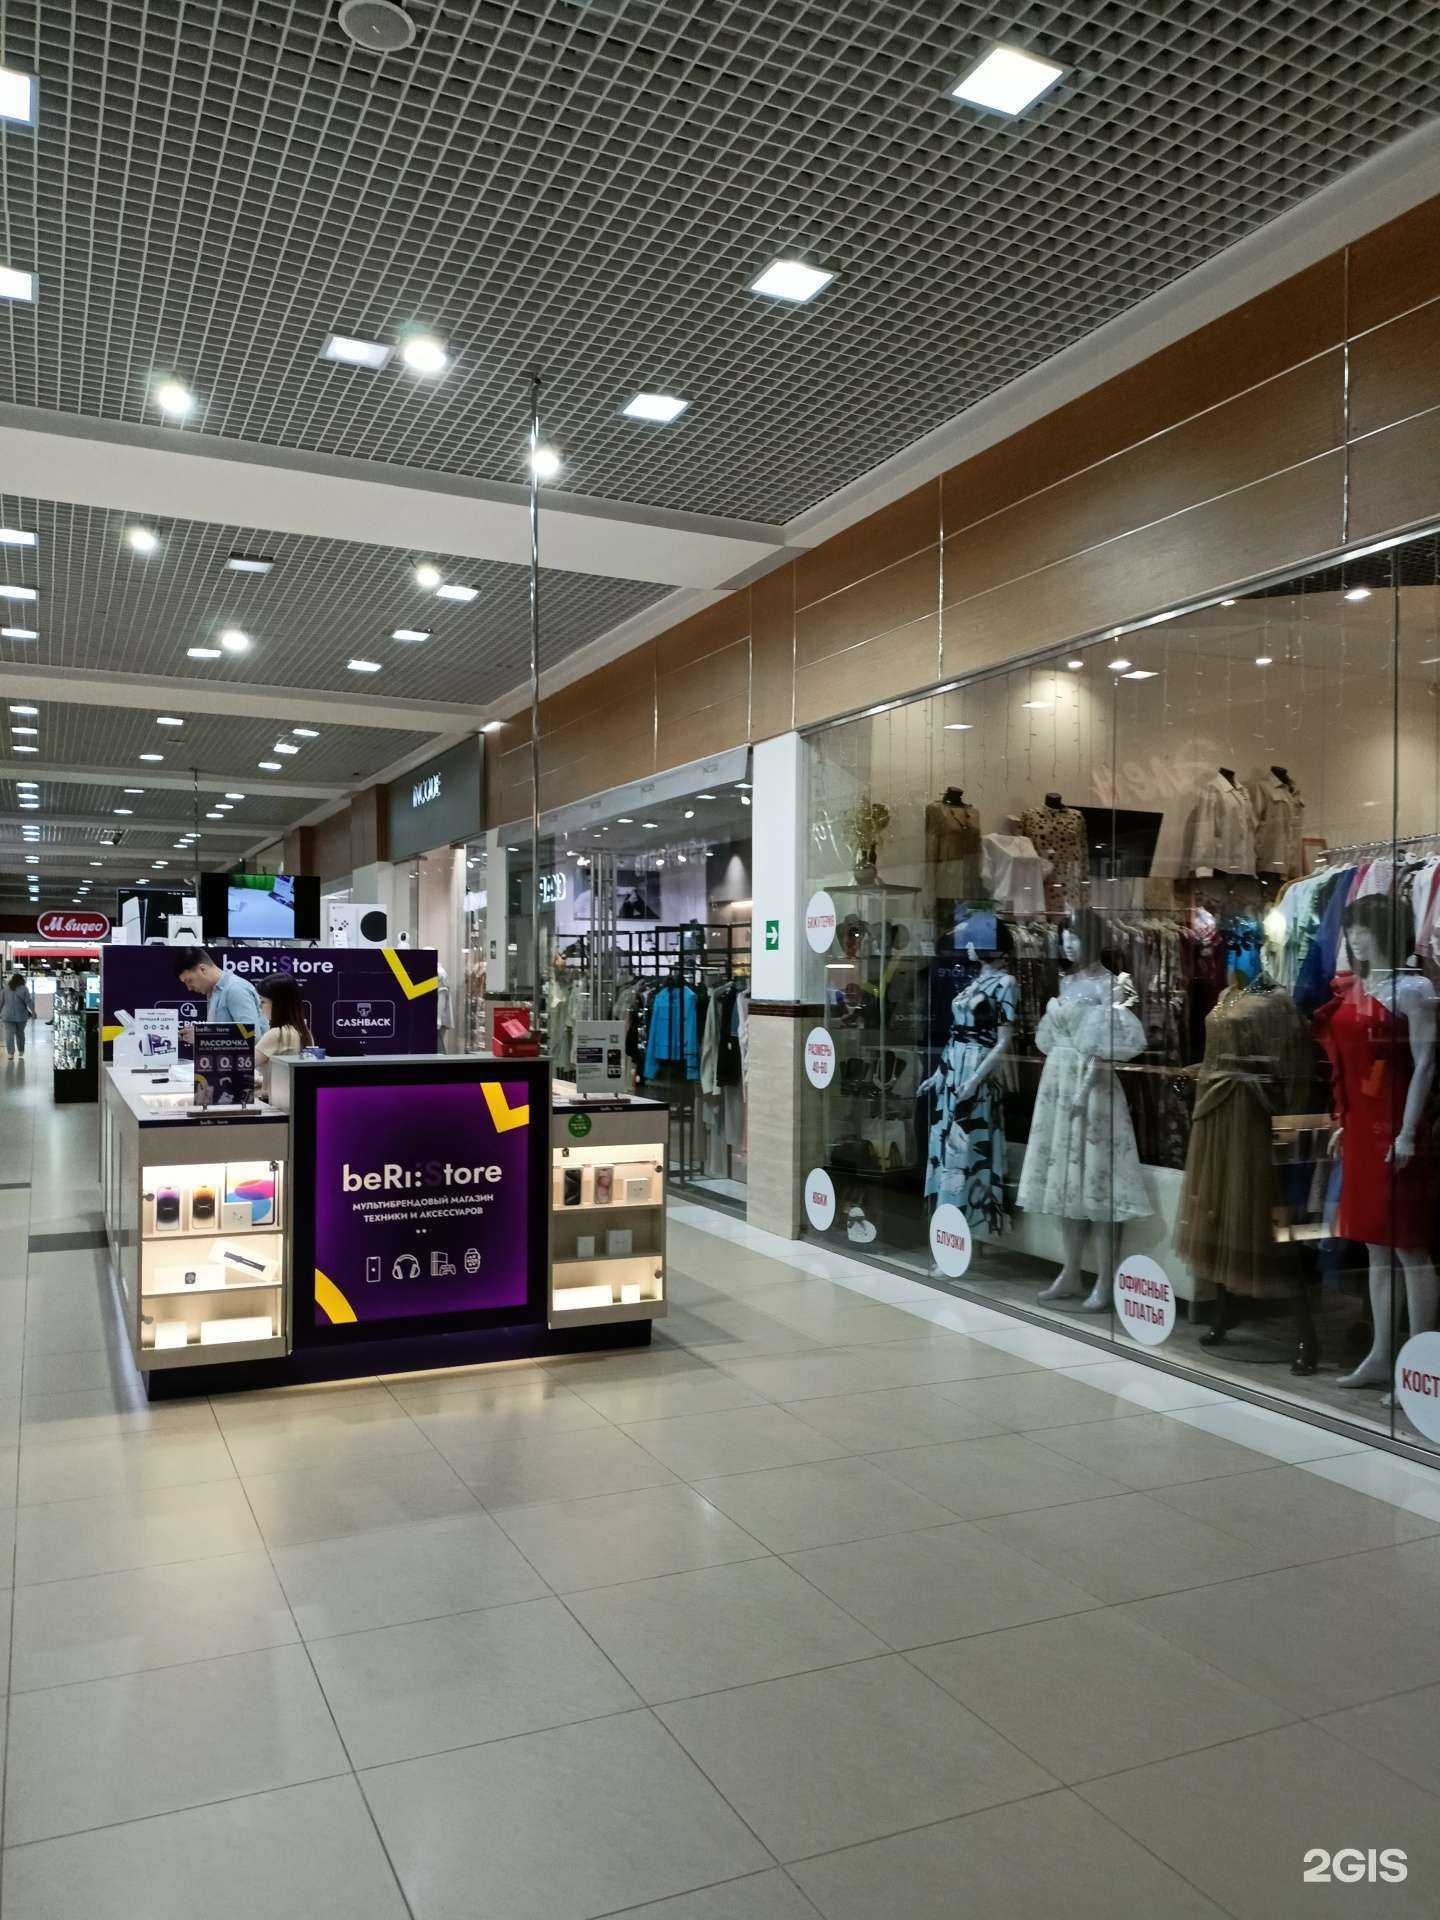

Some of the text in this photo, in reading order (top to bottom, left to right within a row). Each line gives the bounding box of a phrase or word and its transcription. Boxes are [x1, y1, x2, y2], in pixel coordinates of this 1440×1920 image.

[336, 1018, 391, 1028] CASHBACK
[352, 1193, 494, 1212] МУЛЬТИБРЕНДОВЫЙ МАГАЗИН
[363, 1206, 484, 1223] ТЕХНИКИ И АКСЕССУАРОВ
[936, 1229, 965, 1252] БЛУЗКИ
[1119, 1273, 1169, 1302] ОФИСНЫЕ
[1124, 1299, 1165, 1326] ПЛАТЬЯ
